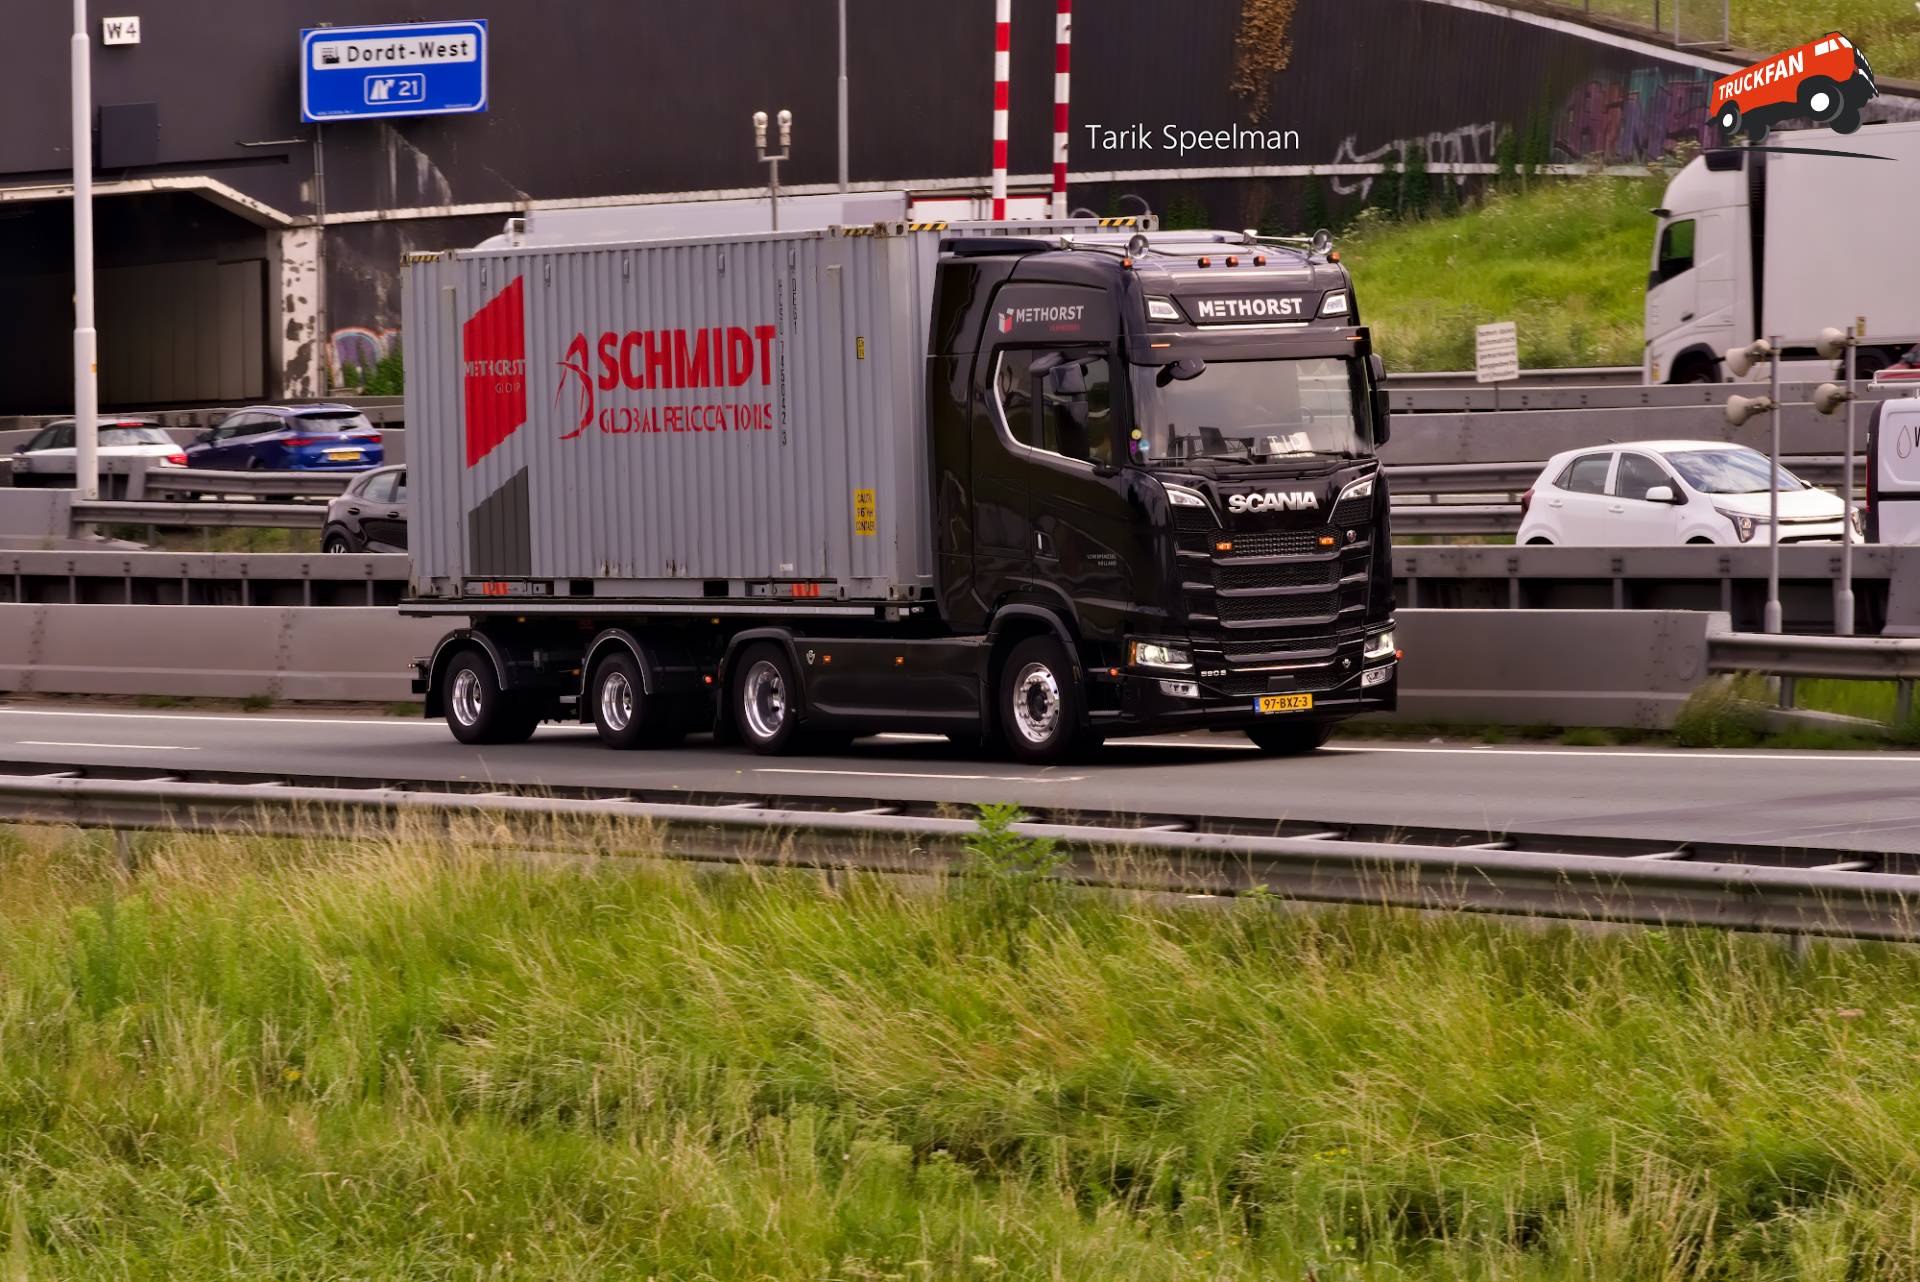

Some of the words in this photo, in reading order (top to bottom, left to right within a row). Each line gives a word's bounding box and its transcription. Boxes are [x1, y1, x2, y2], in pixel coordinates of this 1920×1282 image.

[347, 40, 469, 63] Dordt-West
[398, 80, 419, 97] 21
[1016, 305, 1084, 322] METHORST
[1197, 298, 1303, 317] METHORST
[597, 325, 776, 392] SCHMIDT
[598, 406, 661, 434] GLOBAL
[663, 402, 773, 433] RELOCATIONS
[1228, 491, 1319, 513] SCANIA
[1264, 696, 1308, 709] 97-BXZ-3
